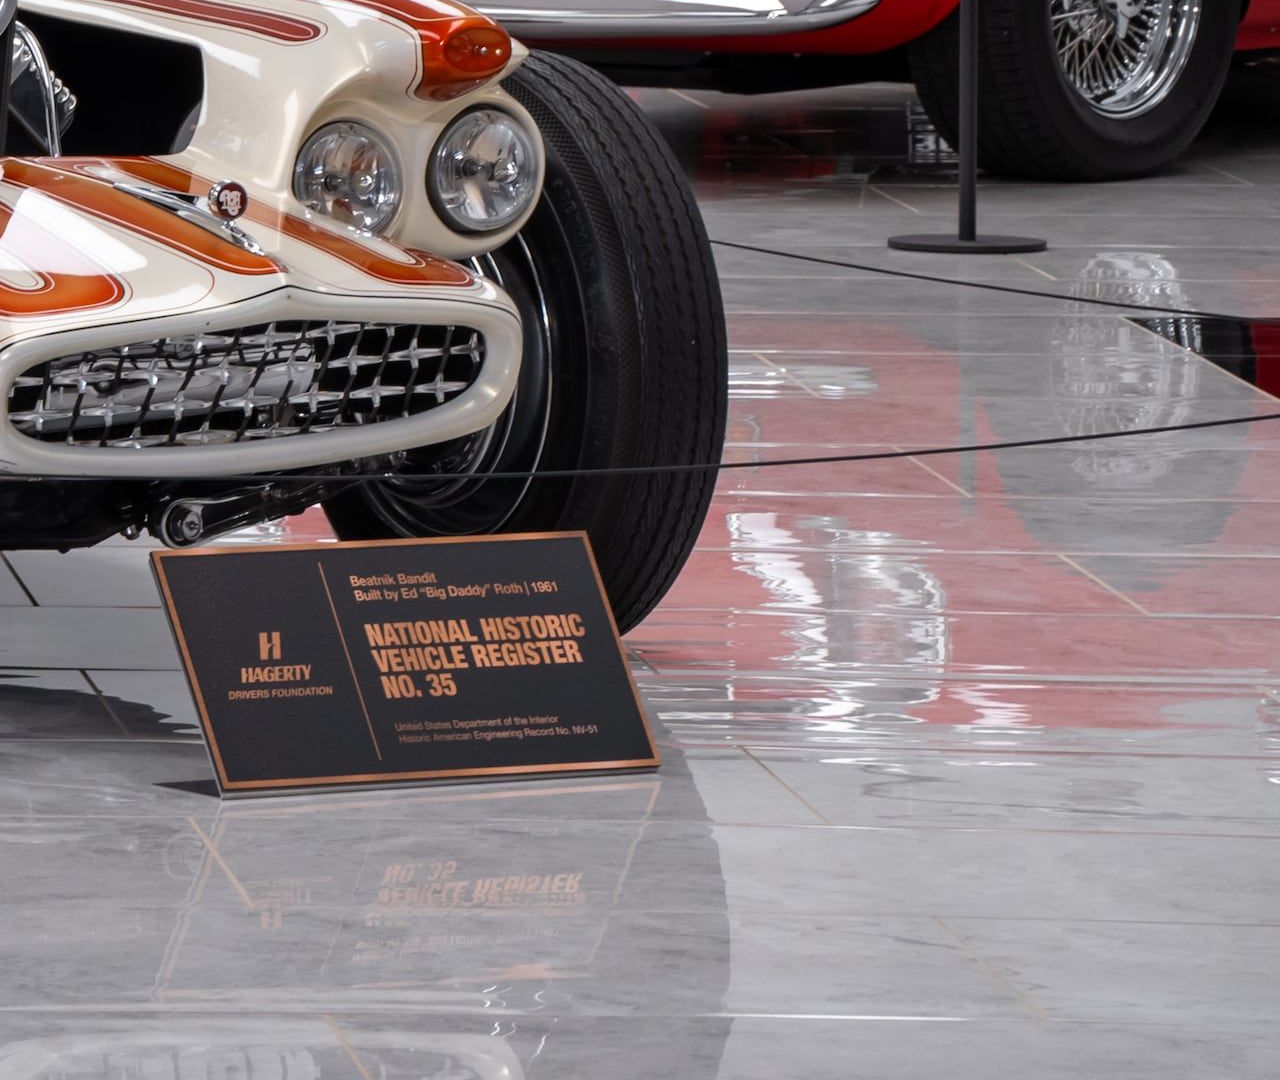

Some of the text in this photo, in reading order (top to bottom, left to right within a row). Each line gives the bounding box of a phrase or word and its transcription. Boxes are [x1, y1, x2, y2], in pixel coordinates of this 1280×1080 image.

[349, 572, 437, 587] Beatnik Bandit
[354, 590, 384, 602] Built
[386, 588, 399, 602] by
[401, 587, 418, 600] Ed
[420, 586, 447, 600] “Big
[450, 583, 491, 598] Daddy”
[494, 582, 523, 595] Roth
[531, 580, 559, 593] 1961
[364, 613, 586, 647] NATIONAL HISTORIC
[370, 639, 584, 673] VEHICLE REGISTER
[241, 664, 312, 684] HAGERTY
[228, 686, 333, 700] DRIVERS FOUNDATION
[380, 673, 458, 699] NO. 35
[394, 714, 559, 732] United States Department of the Interior
[398, 723, 599, 744] Historic American Engineering Record No. NV-51
